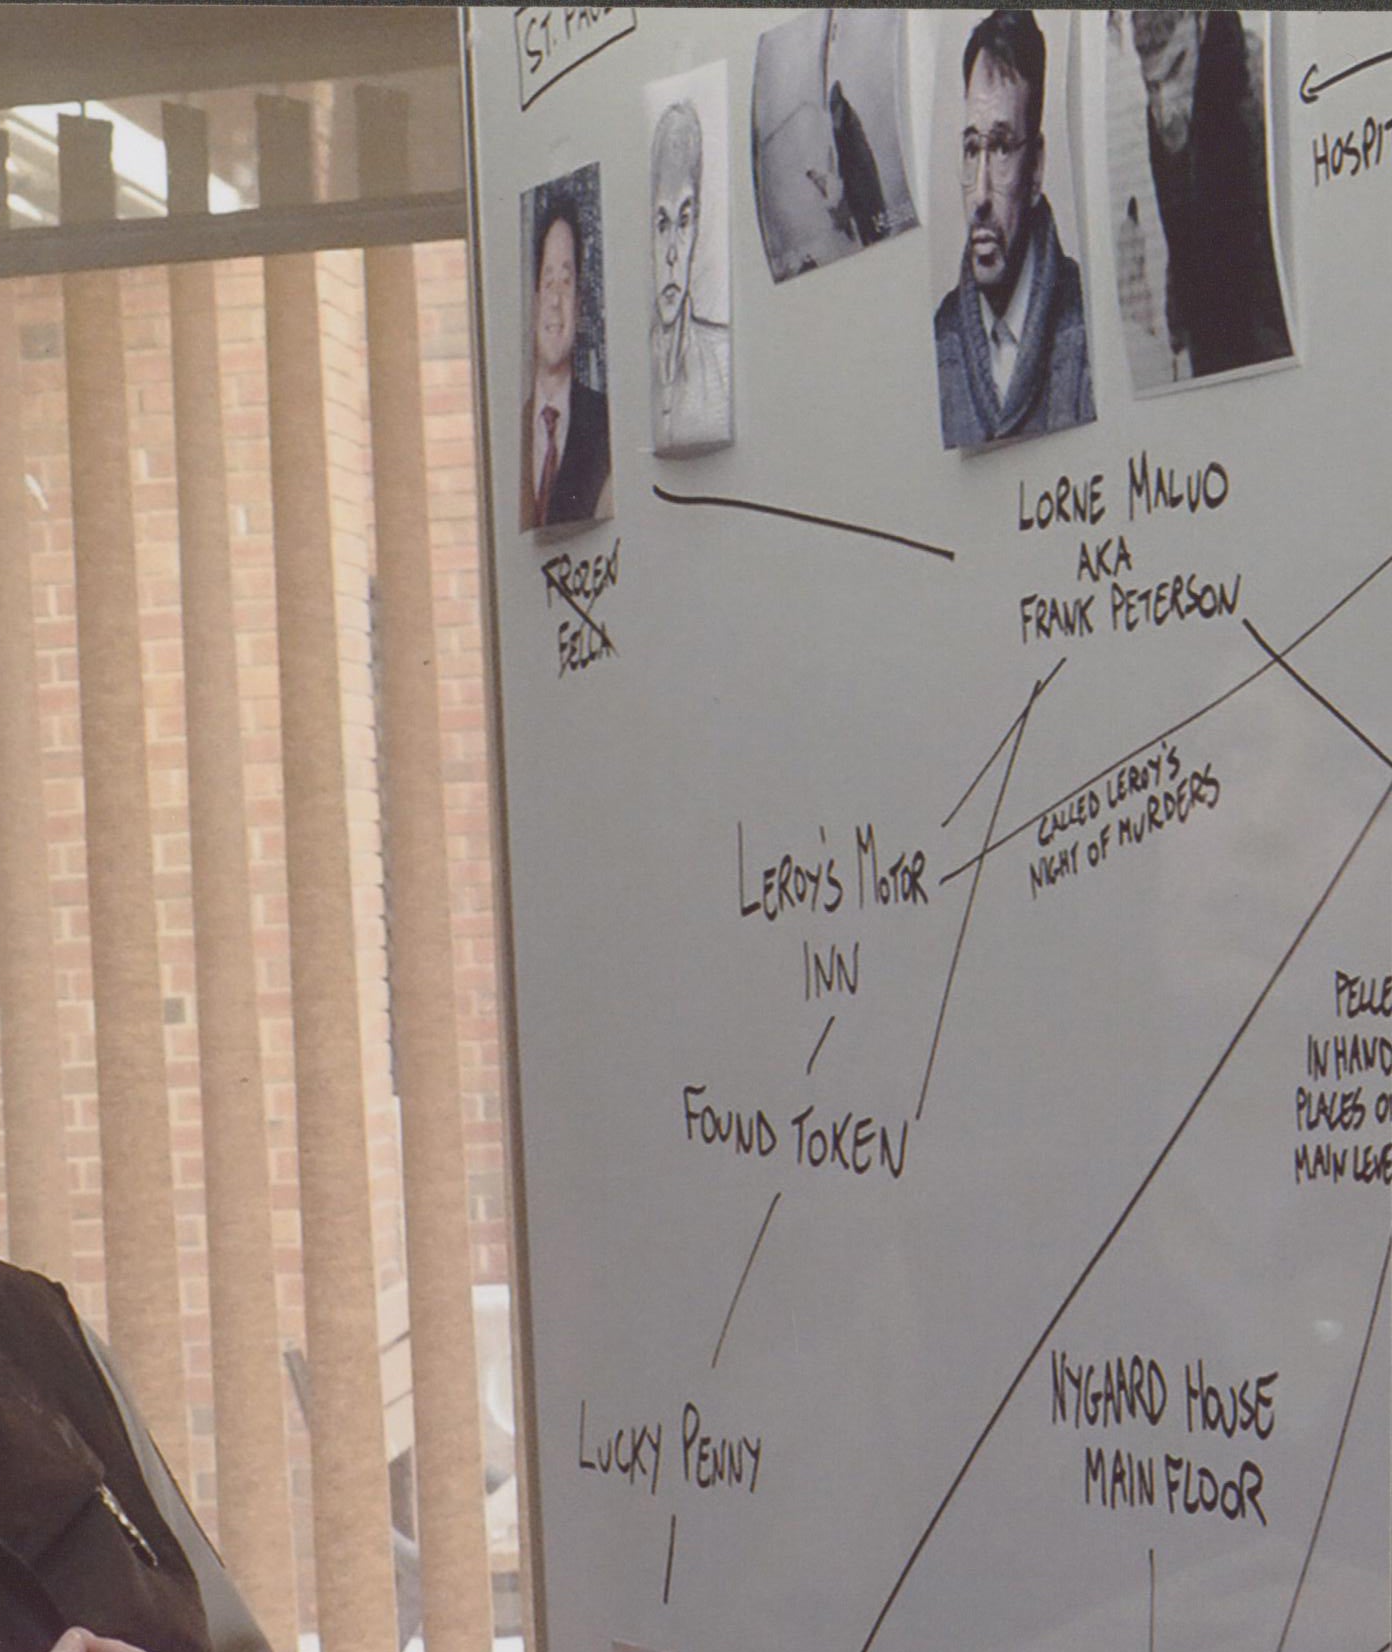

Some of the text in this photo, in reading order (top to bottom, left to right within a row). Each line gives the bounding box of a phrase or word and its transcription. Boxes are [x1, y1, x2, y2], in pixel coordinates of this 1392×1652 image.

[524, 10, 557, 74] ST.
[1313, 117, 1392, 187] HOSPI
[1019, 475, 1106, 531] LORNE
[1077, 535, 1132, 582] AKA
[1020, 573, 1241, 644] FRANK PETERSON
[1030, 762, 1220, 899] NIGHT OF MURDERS
[1038, 790, 1100, 846] CALLED
[737, 821, 929, 921] LEROY'S MOTOR
[803, 940, 859, 1001] INN
[1307, 1034, 1330, 1081] IN
[683, 1085, 908, 1179] FOUND TOKEN
[1296, 1086, 1392, 1131] PLACES O
[1295, 1143, 1348, 1184] MAIN
[1185, 1359, 1278, 1440] HOUSE
[579, 1400, 762, 1495] LUCKY PENNY
[1085, 1447, 1267, 1527] MAIN FLOOR
